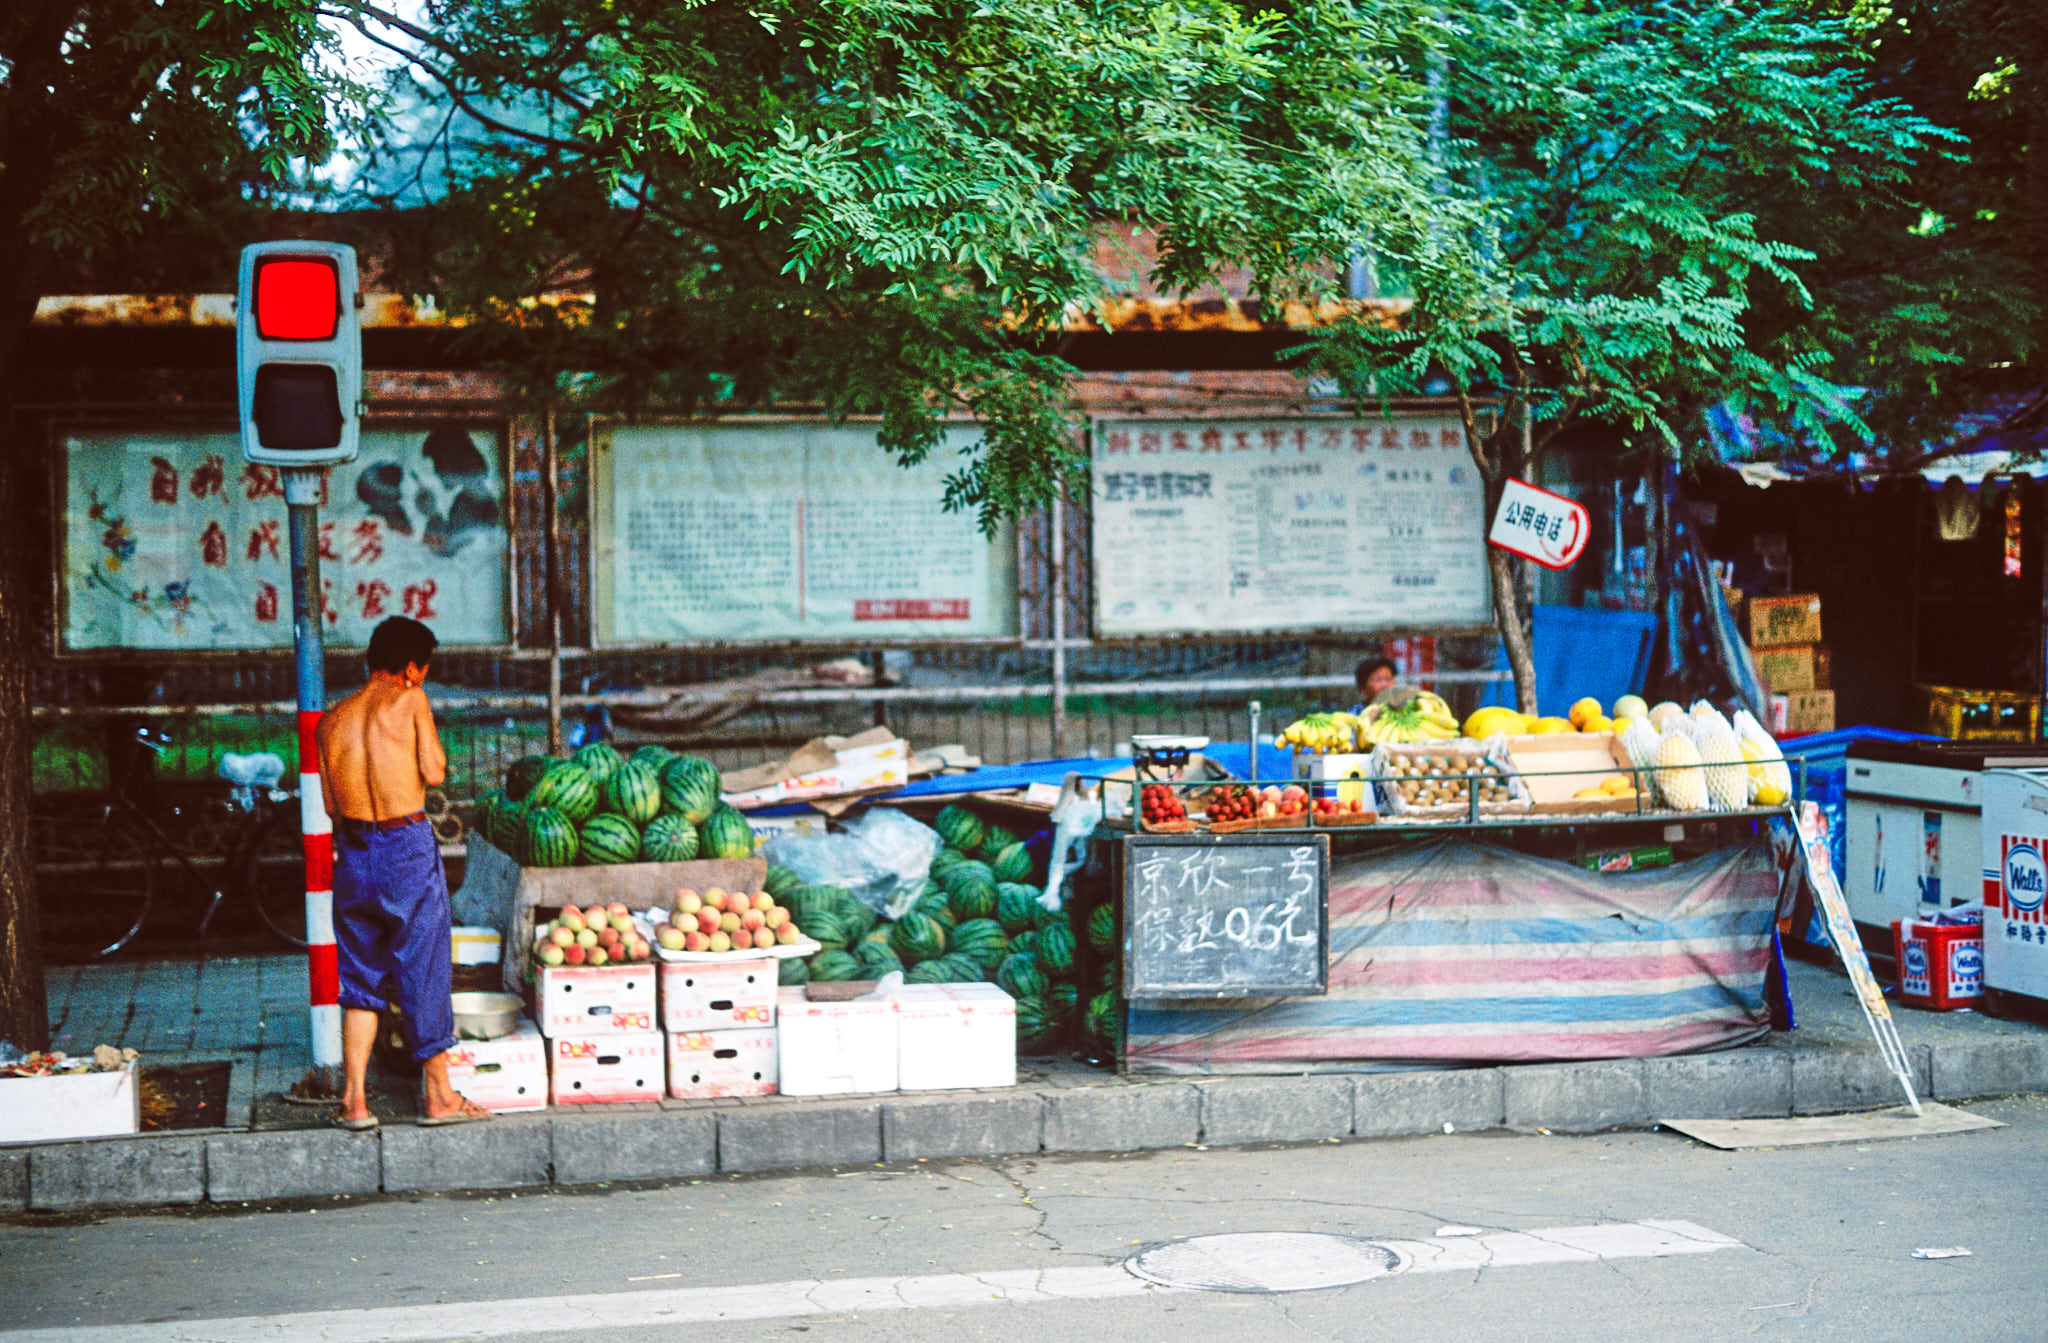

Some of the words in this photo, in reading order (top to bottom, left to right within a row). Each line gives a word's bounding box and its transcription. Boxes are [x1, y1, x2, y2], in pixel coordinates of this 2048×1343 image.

[151, 455, 333, 508] 自我教
[1504, 500, 1563, 542] 公用电话
[1136, 846, 1318, 905] 京欣一号
[2009, 862, 2043, 892] Wall's
